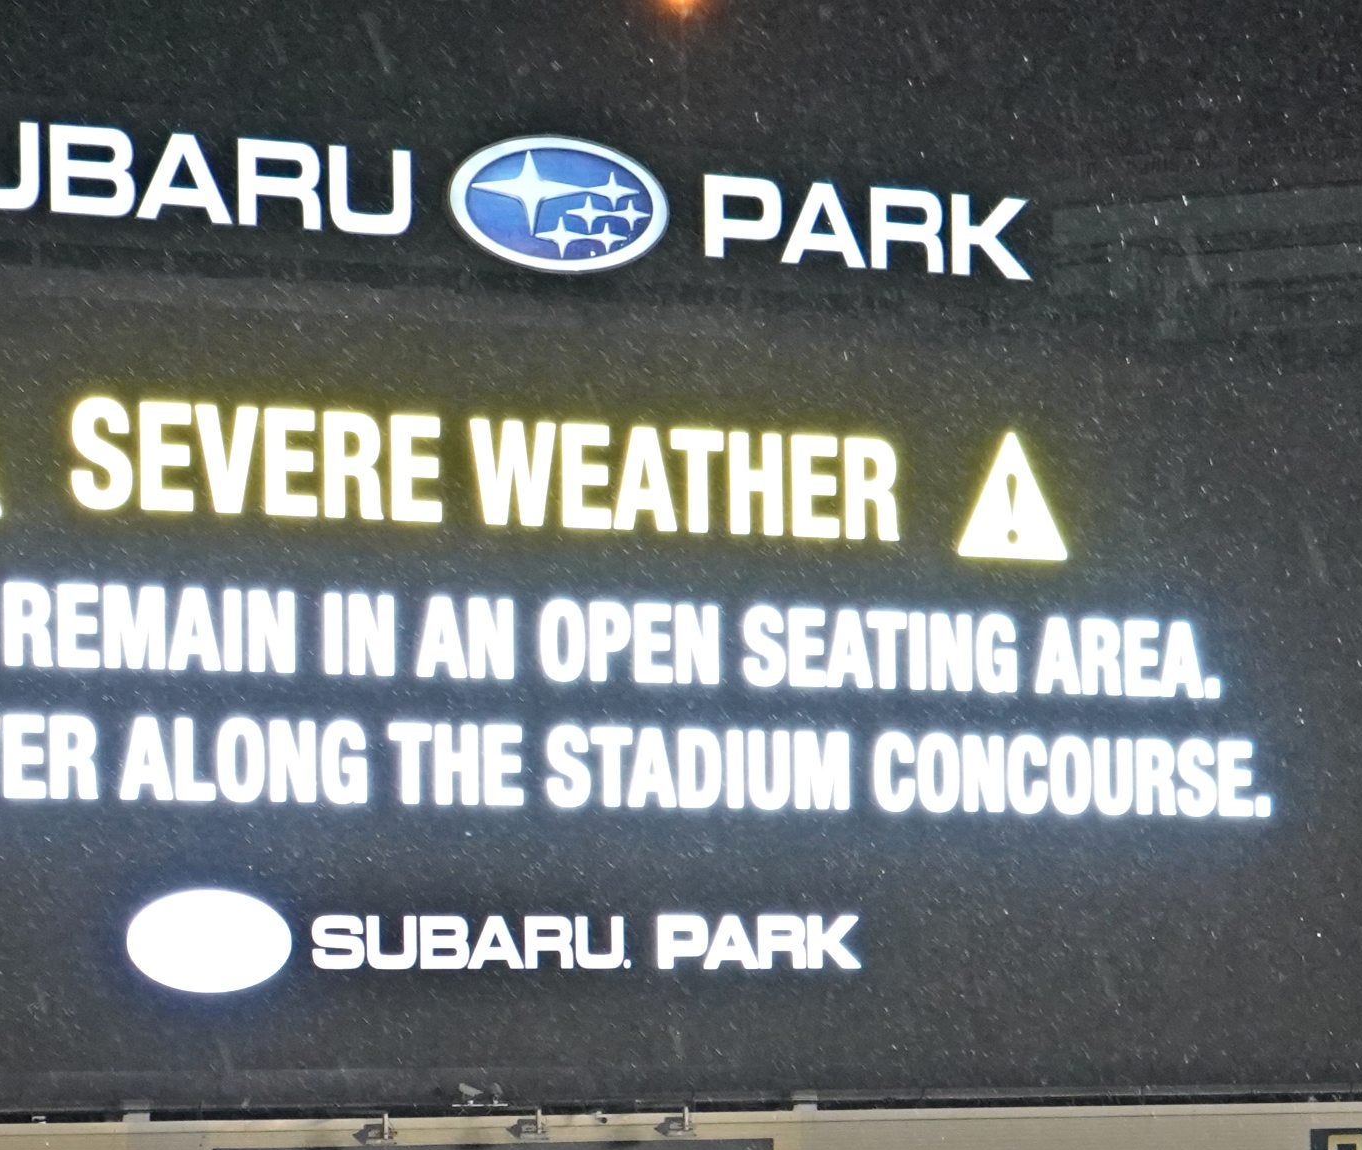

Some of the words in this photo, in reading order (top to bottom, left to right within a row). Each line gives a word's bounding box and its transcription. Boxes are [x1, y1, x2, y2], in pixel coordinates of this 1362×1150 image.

[703, 173, 1033, 281] PARK
[70, 394, 443, 524] SEVERE
[469, 416, 901, 543] WEATHER
[2, 580, 297, 675] REMAIN
[322, 591, 397, 678] IN
[415, 594, 516, 681] AN
[538, 597, 721, 686] OPEN
[741, 603, 1019, 695] SEATING
[1034, 615, 1222, 700] AREA.
[119, 714, 369, 806] ALONG
[386, 720, 526, 808] THE
[545, 723, 852, 812] STADIUM
[873, 729, 1273, 819] CONCOURSE.
[655, 912, 863, 971] PARK
